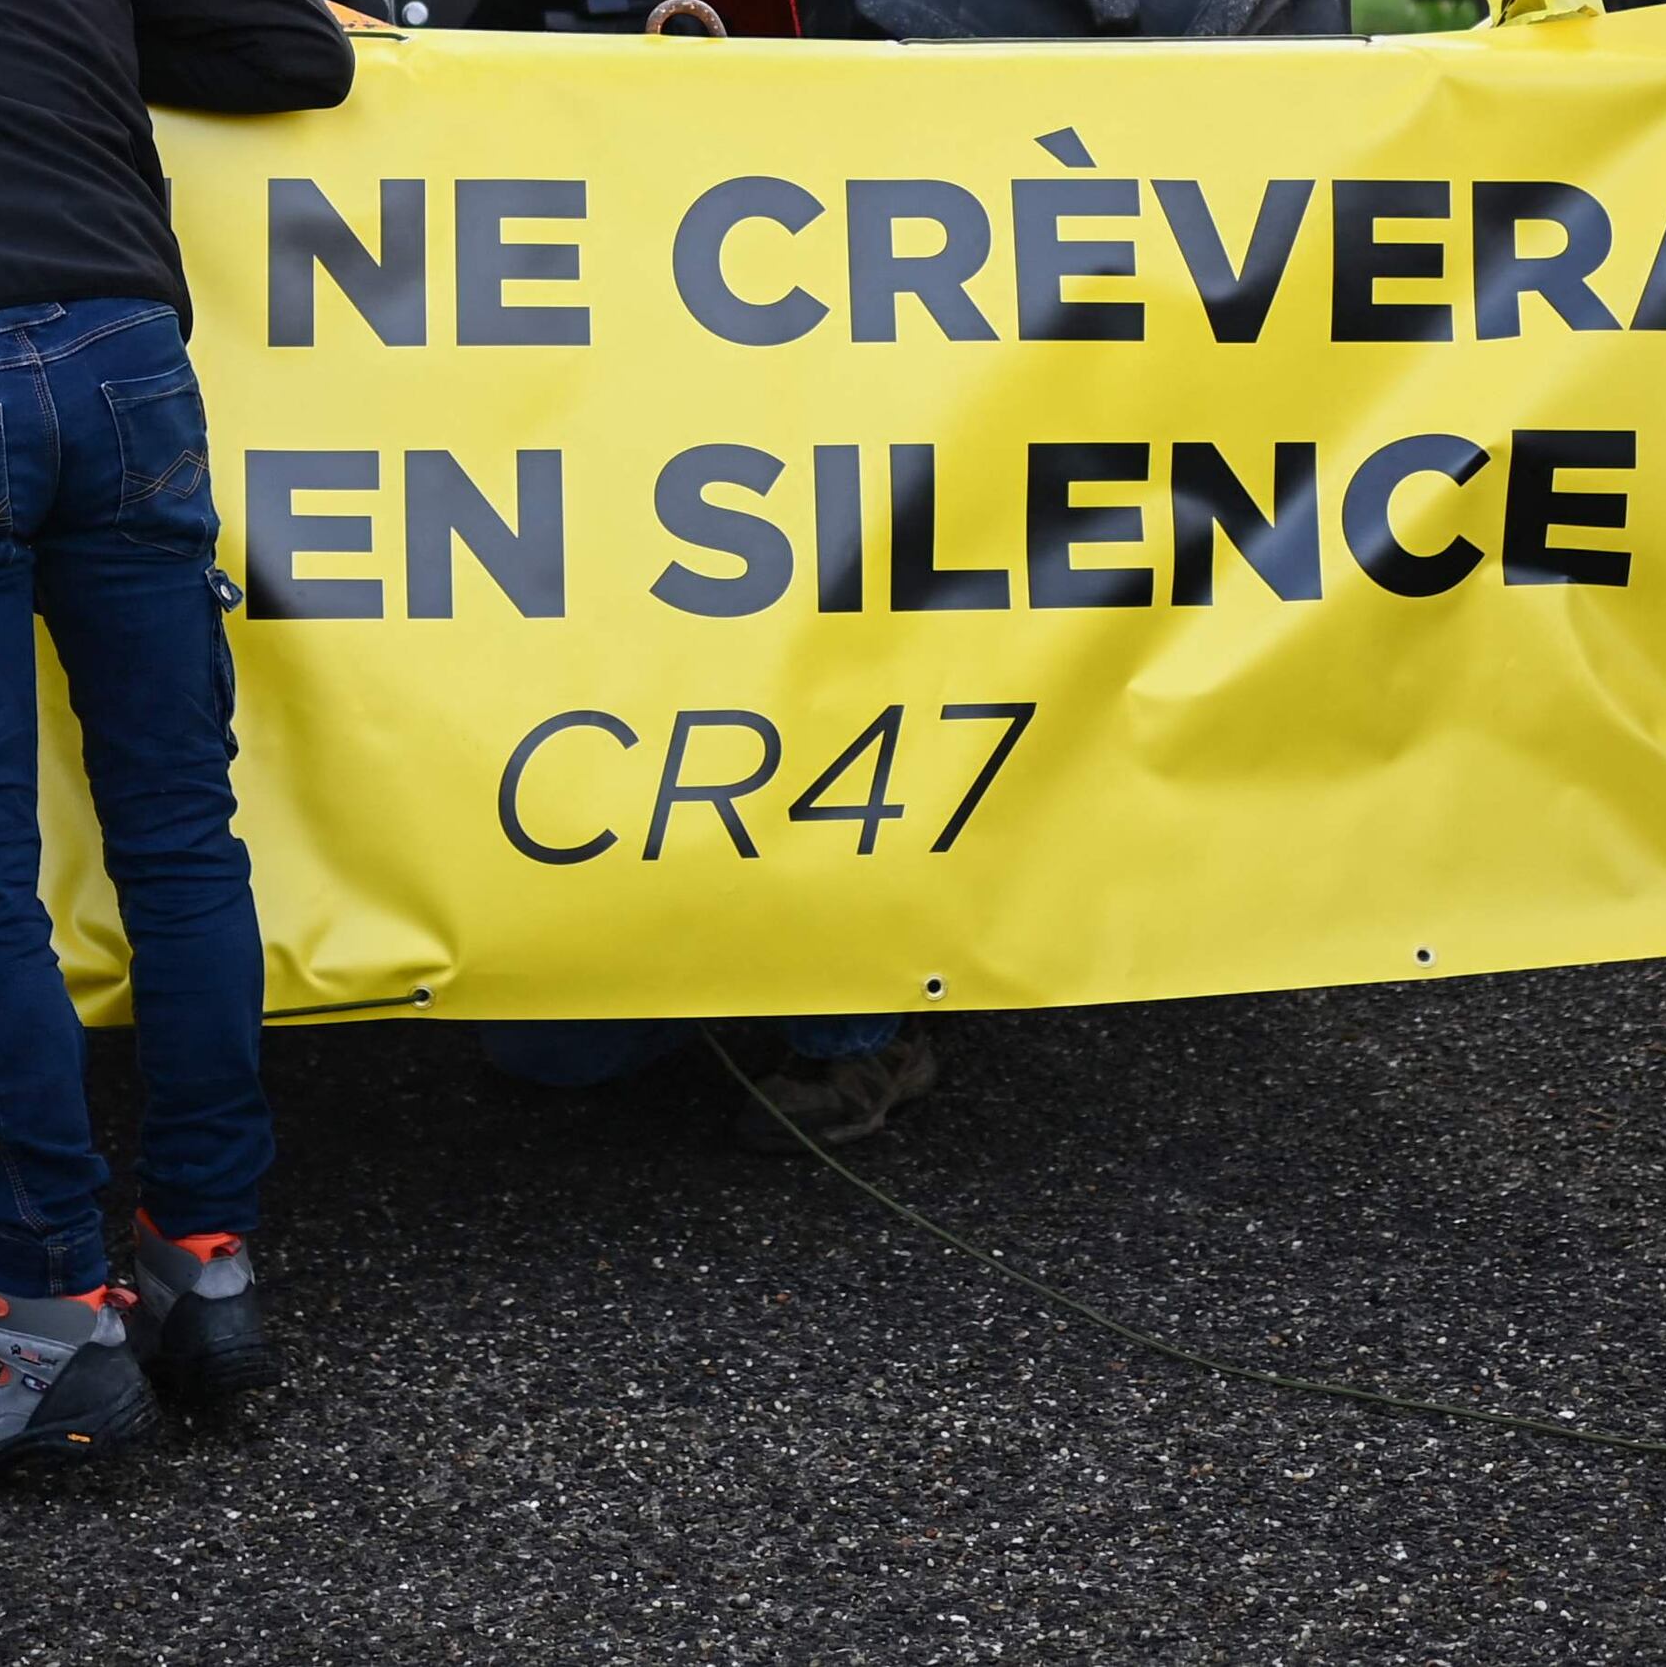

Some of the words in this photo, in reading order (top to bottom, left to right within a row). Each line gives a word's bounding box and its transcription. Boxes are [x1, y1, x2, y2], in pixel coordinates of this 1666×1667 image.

[267, 178, 591, 347] NE
[245, 449, 566, 620] EN
[649, 430, 1637, 613] SILENCE
[497, 701, 1037, 866] CR47
